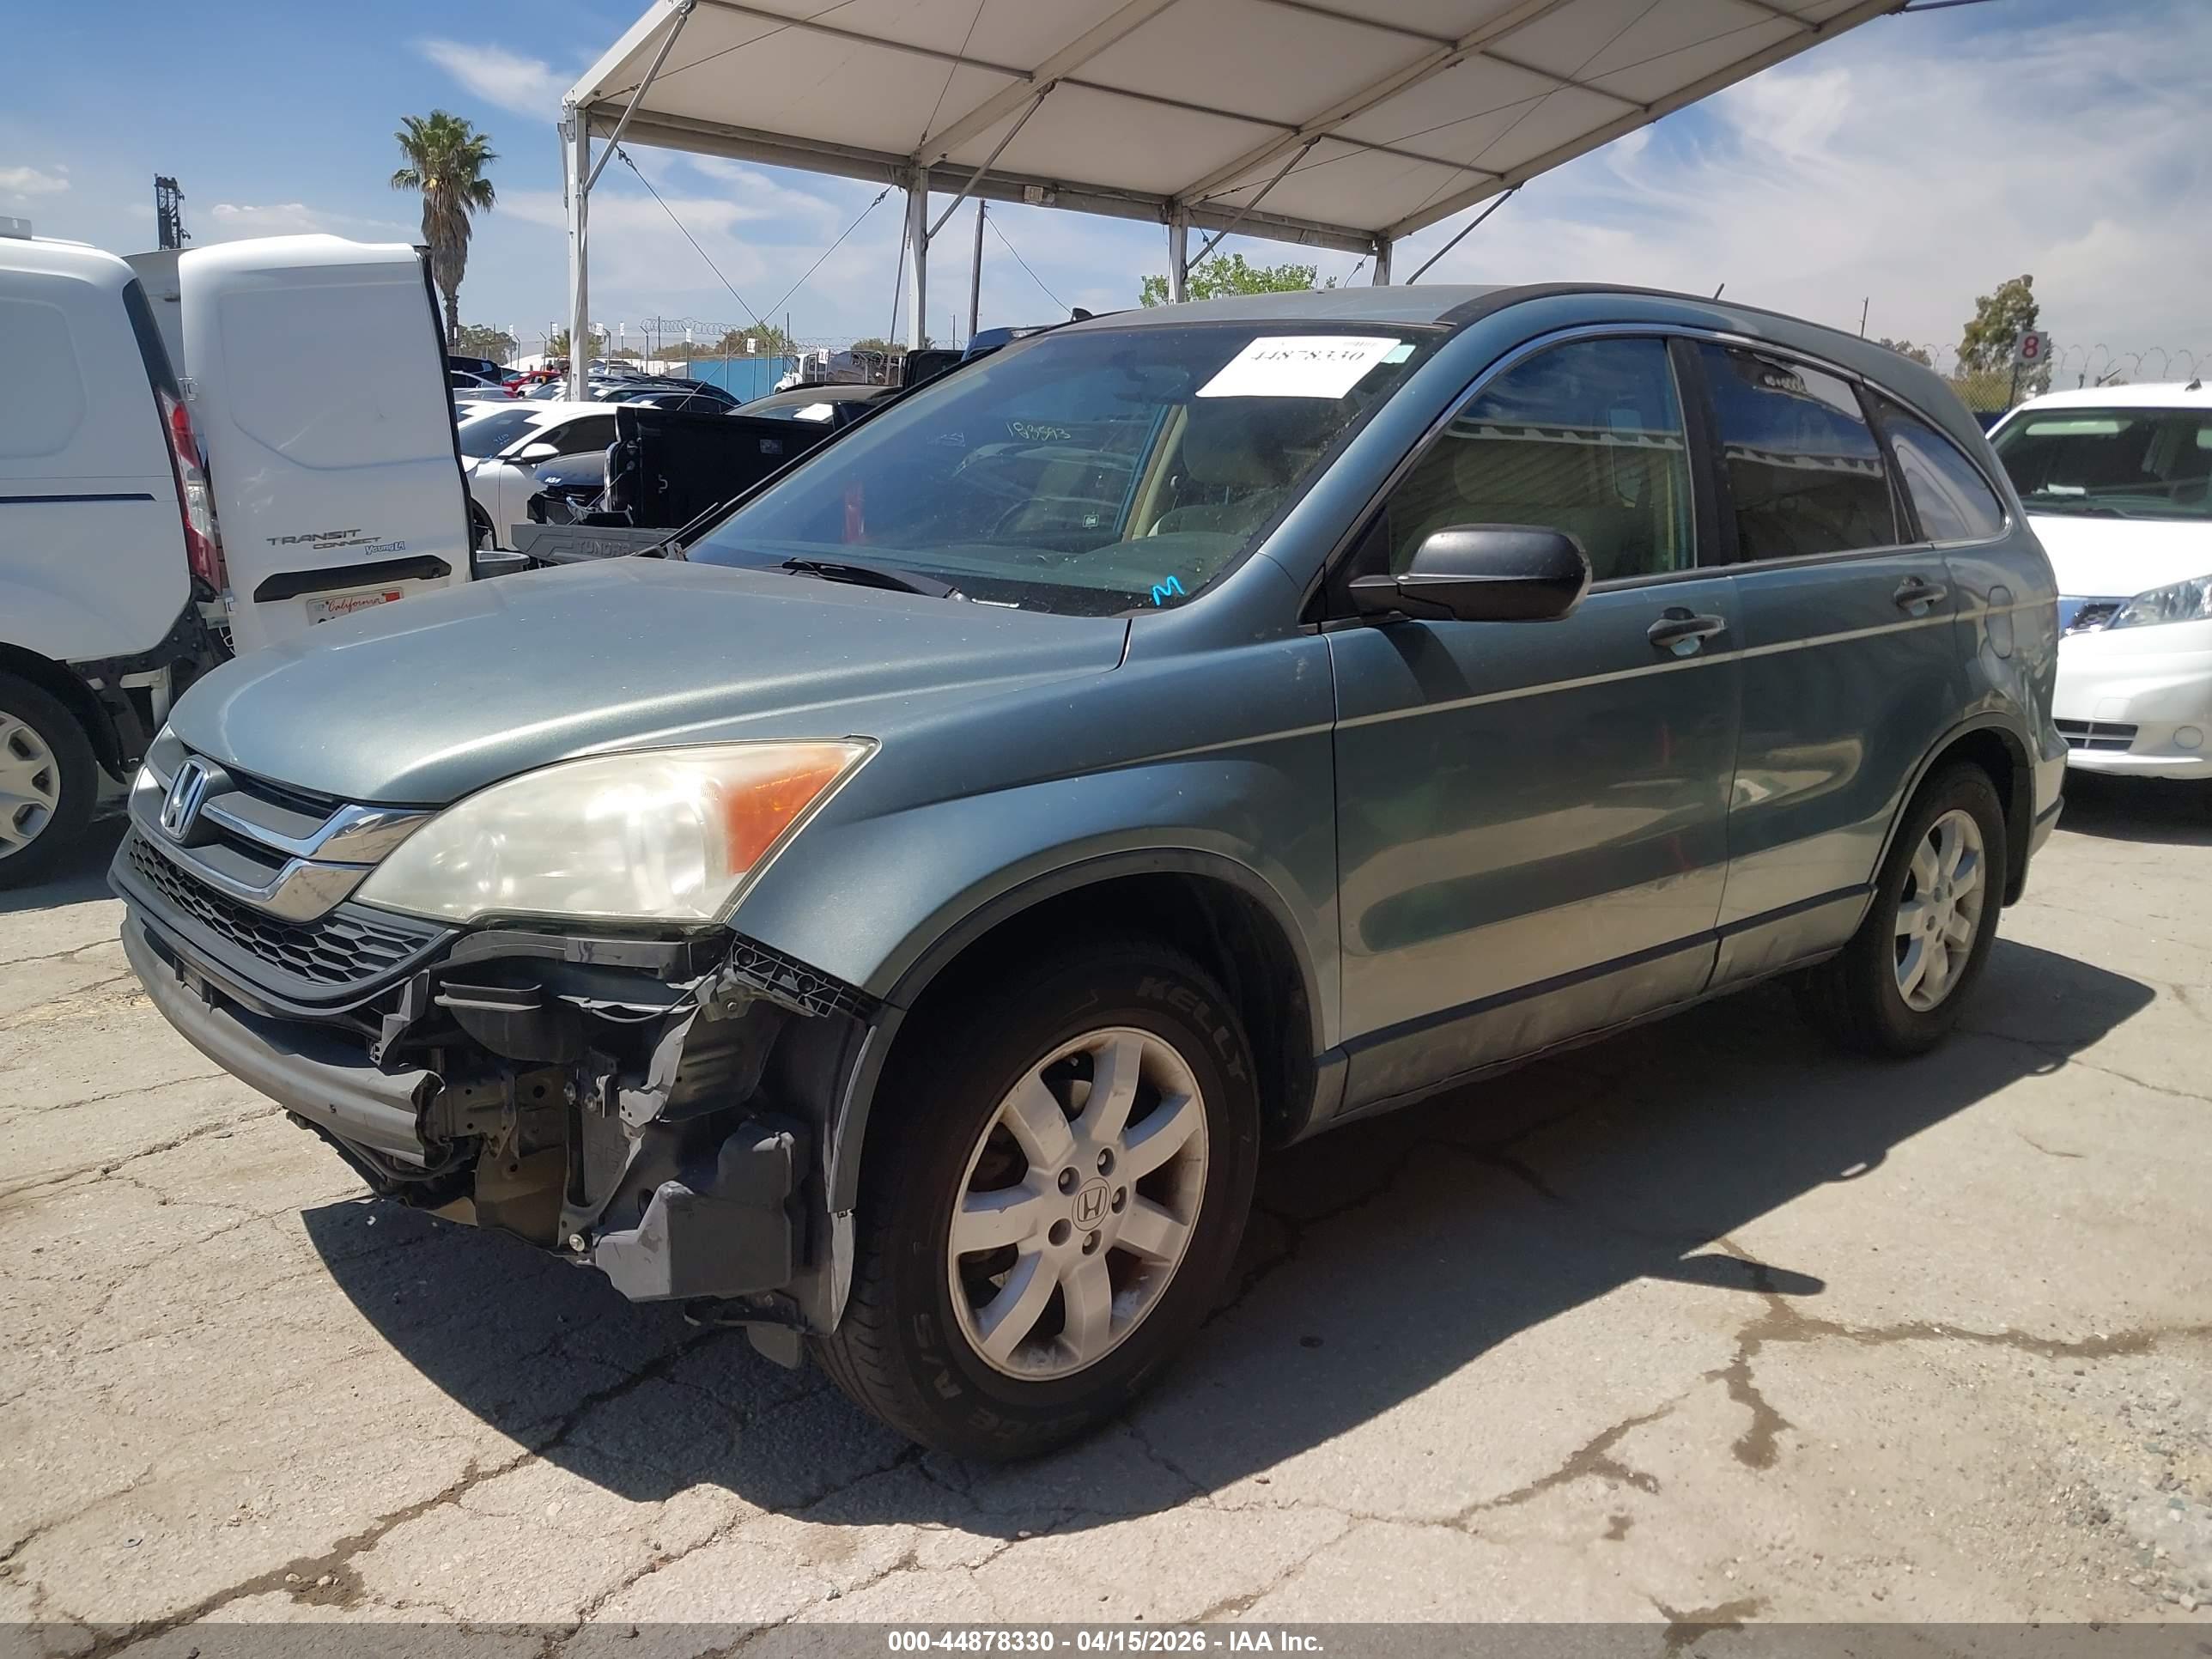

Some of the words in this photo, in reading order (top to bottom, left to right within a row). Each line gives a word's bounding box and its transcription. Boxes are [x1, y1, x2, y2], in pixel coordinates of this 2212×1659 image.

[2021, 335, 2039, 359] 8
[266, 528, 362, 546] TRANSIT
[313, 536, 382, 550] CONNECT
[328, 598, 381, 612] California
[1135, 975, 1248, 1084] KELLY
